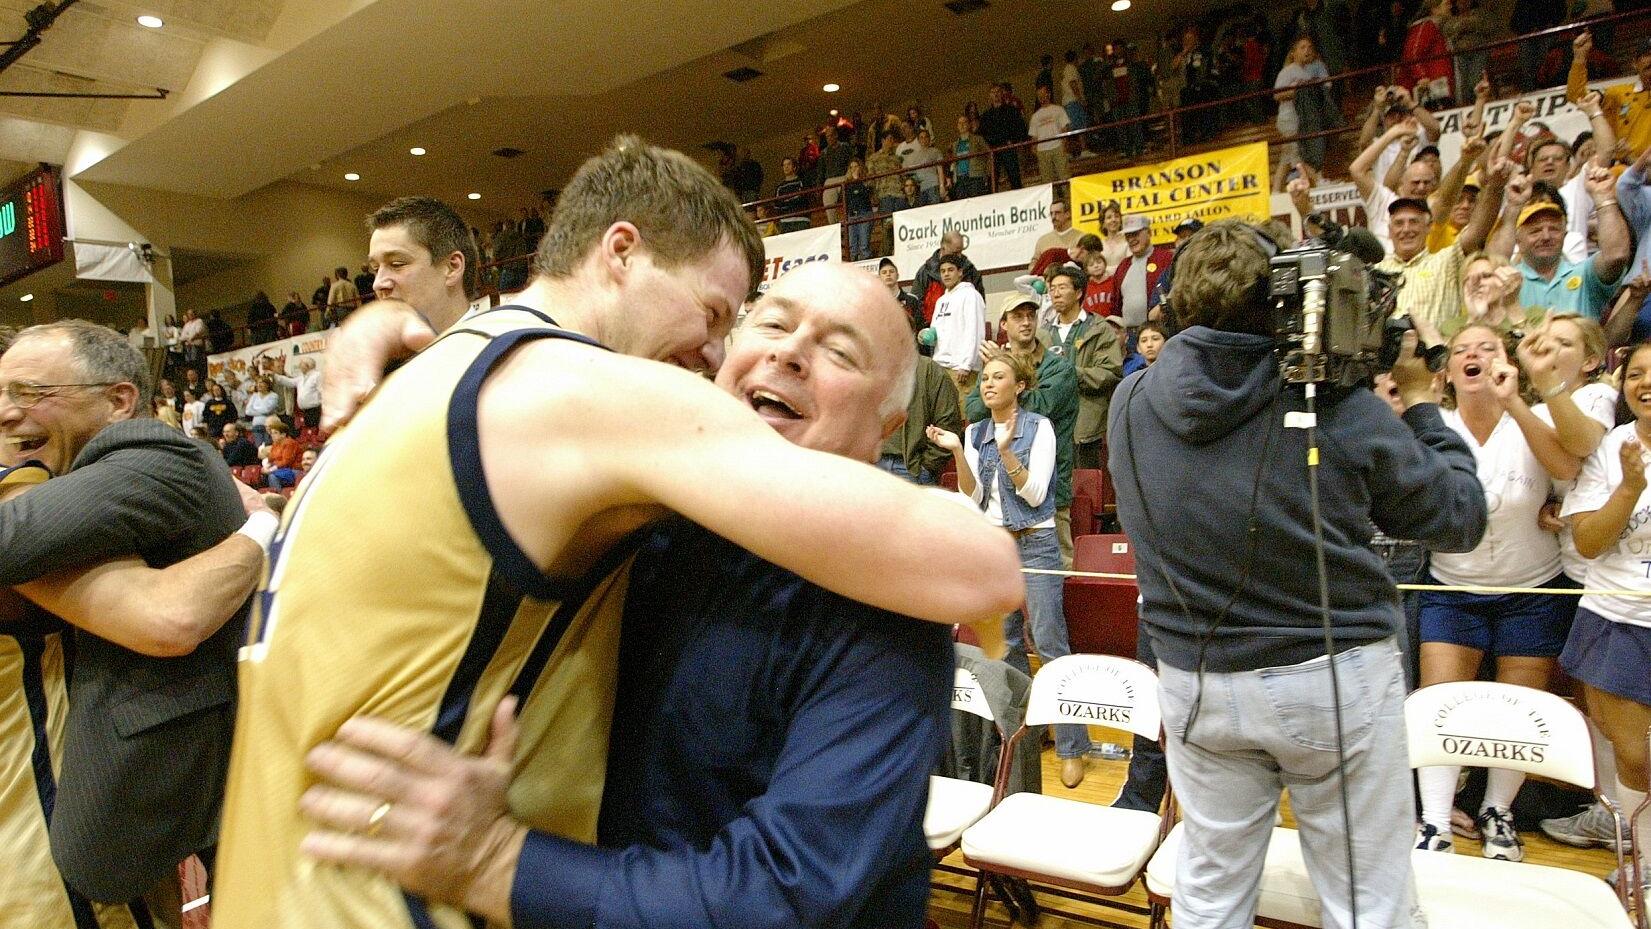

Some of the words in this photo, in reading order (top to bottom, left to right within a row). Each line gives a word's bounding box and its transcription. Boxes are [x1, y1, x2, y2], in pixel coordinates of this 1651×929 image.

[1111, 160, 1222, 193] BRANSON
[1169, 173, 1258, 202] CENTER
[899, 219, 938, 242] Ozark
[942, 209, 1005, 235] Mountain
[1010, 200, 1048, 224] Bank
[1058, 702, 1131, 724] OZARKS
[1442, 737, 1545, 763] OZARKS
